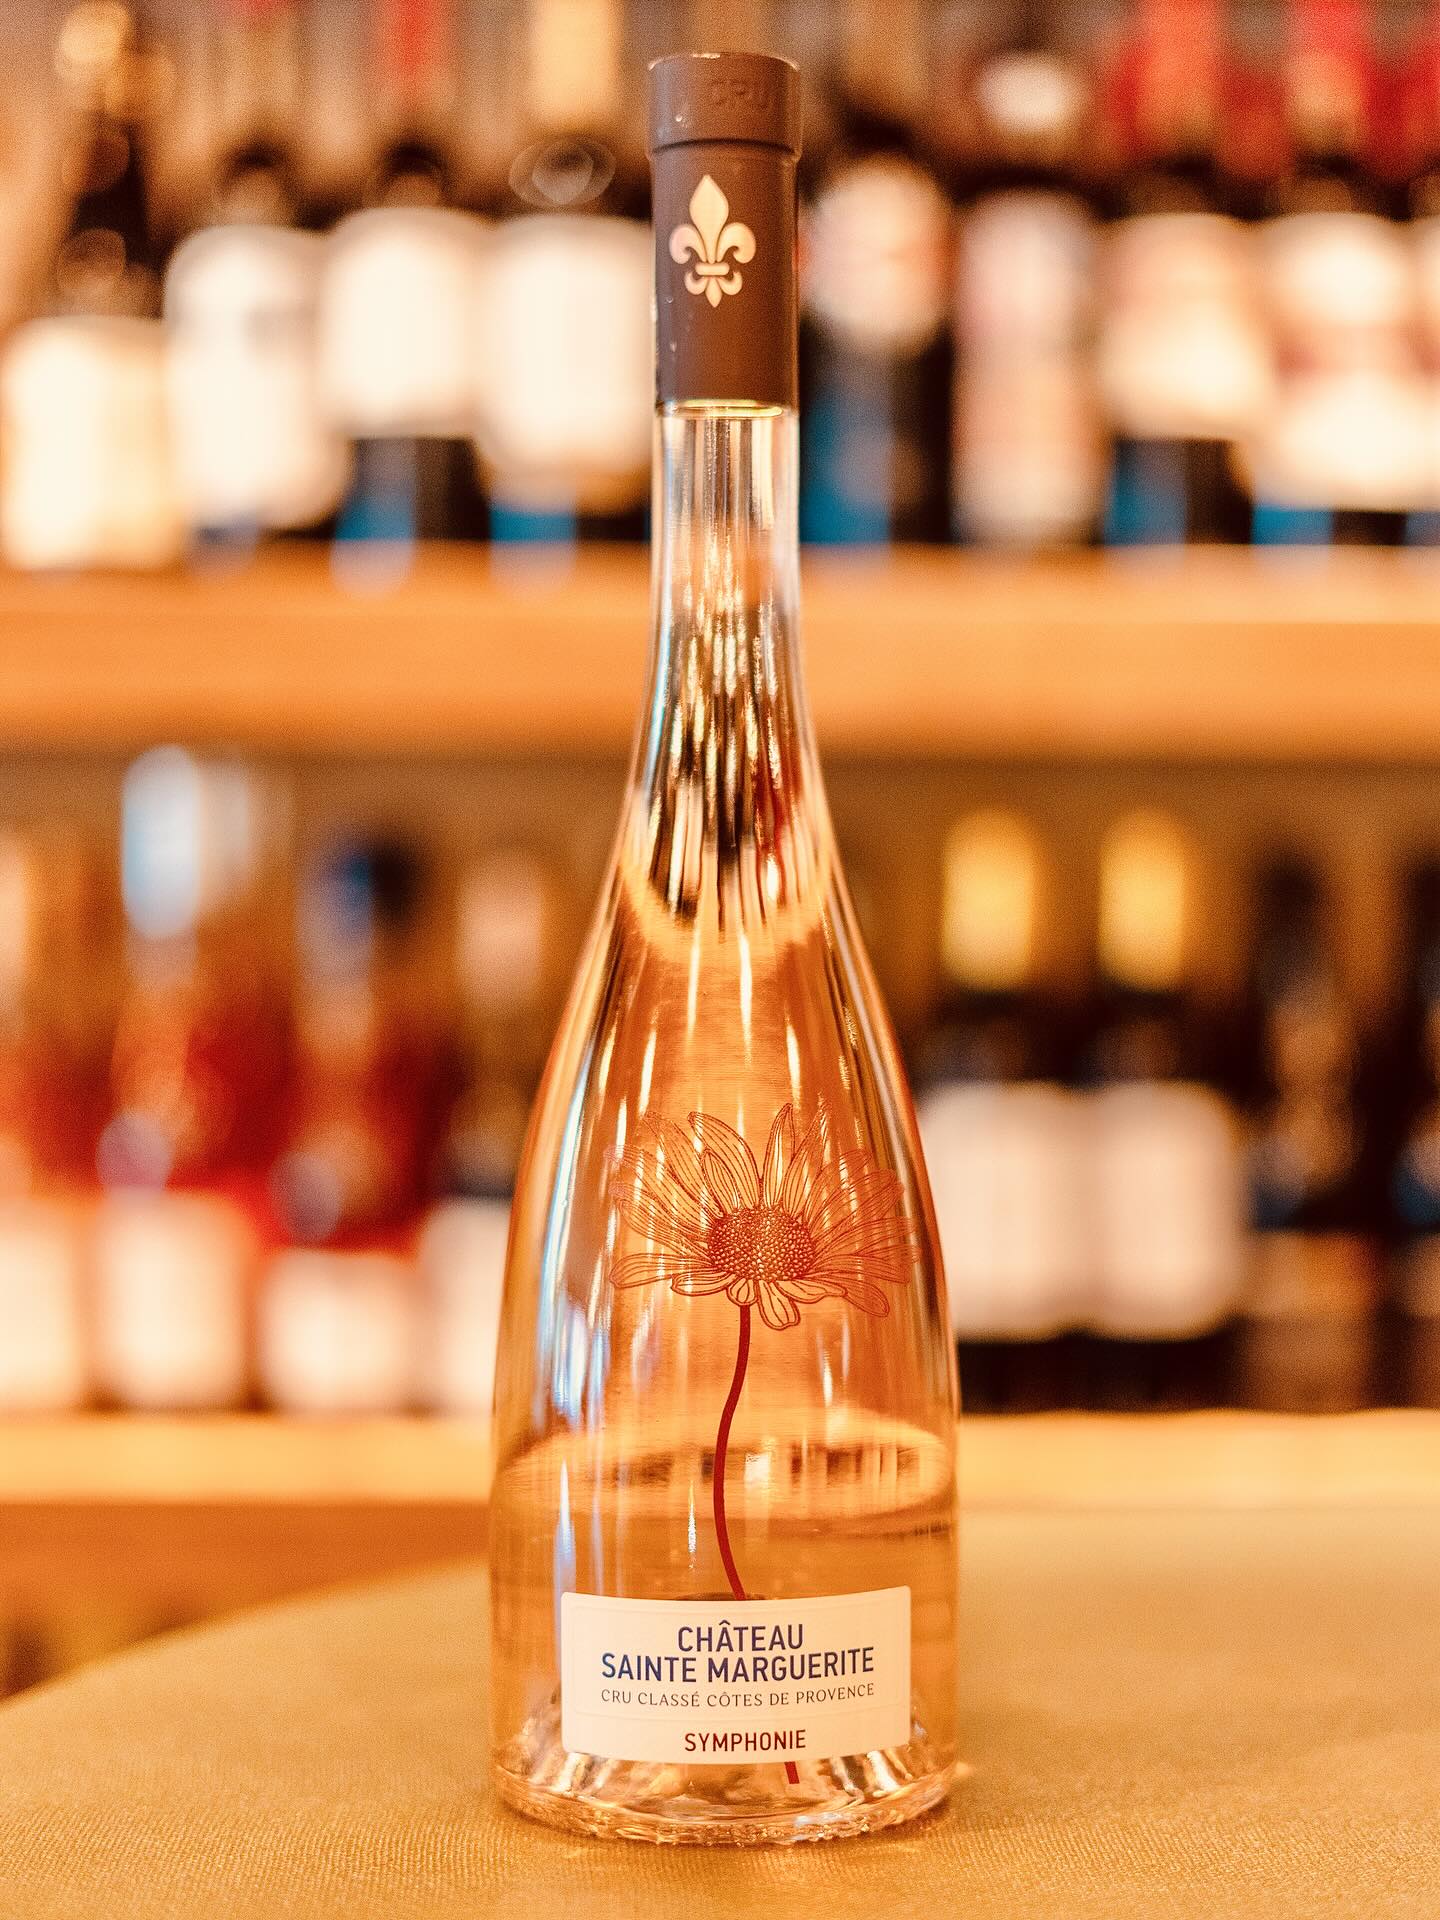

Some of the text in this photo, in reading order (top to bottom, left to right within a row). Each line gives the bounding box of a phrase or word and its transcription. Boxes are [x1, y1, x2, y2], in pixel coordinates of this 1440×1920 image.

[678, 1619, 803, 1652] CHÂTEAU
[601, 1646, 875, 1683] SAINTE MARGUERITE
[601, 1682, 875, 1707] CRU CLASSÉ CÔTES DE PROVENCE
[684, 1729, 807, 1752] SYMPHONIE
